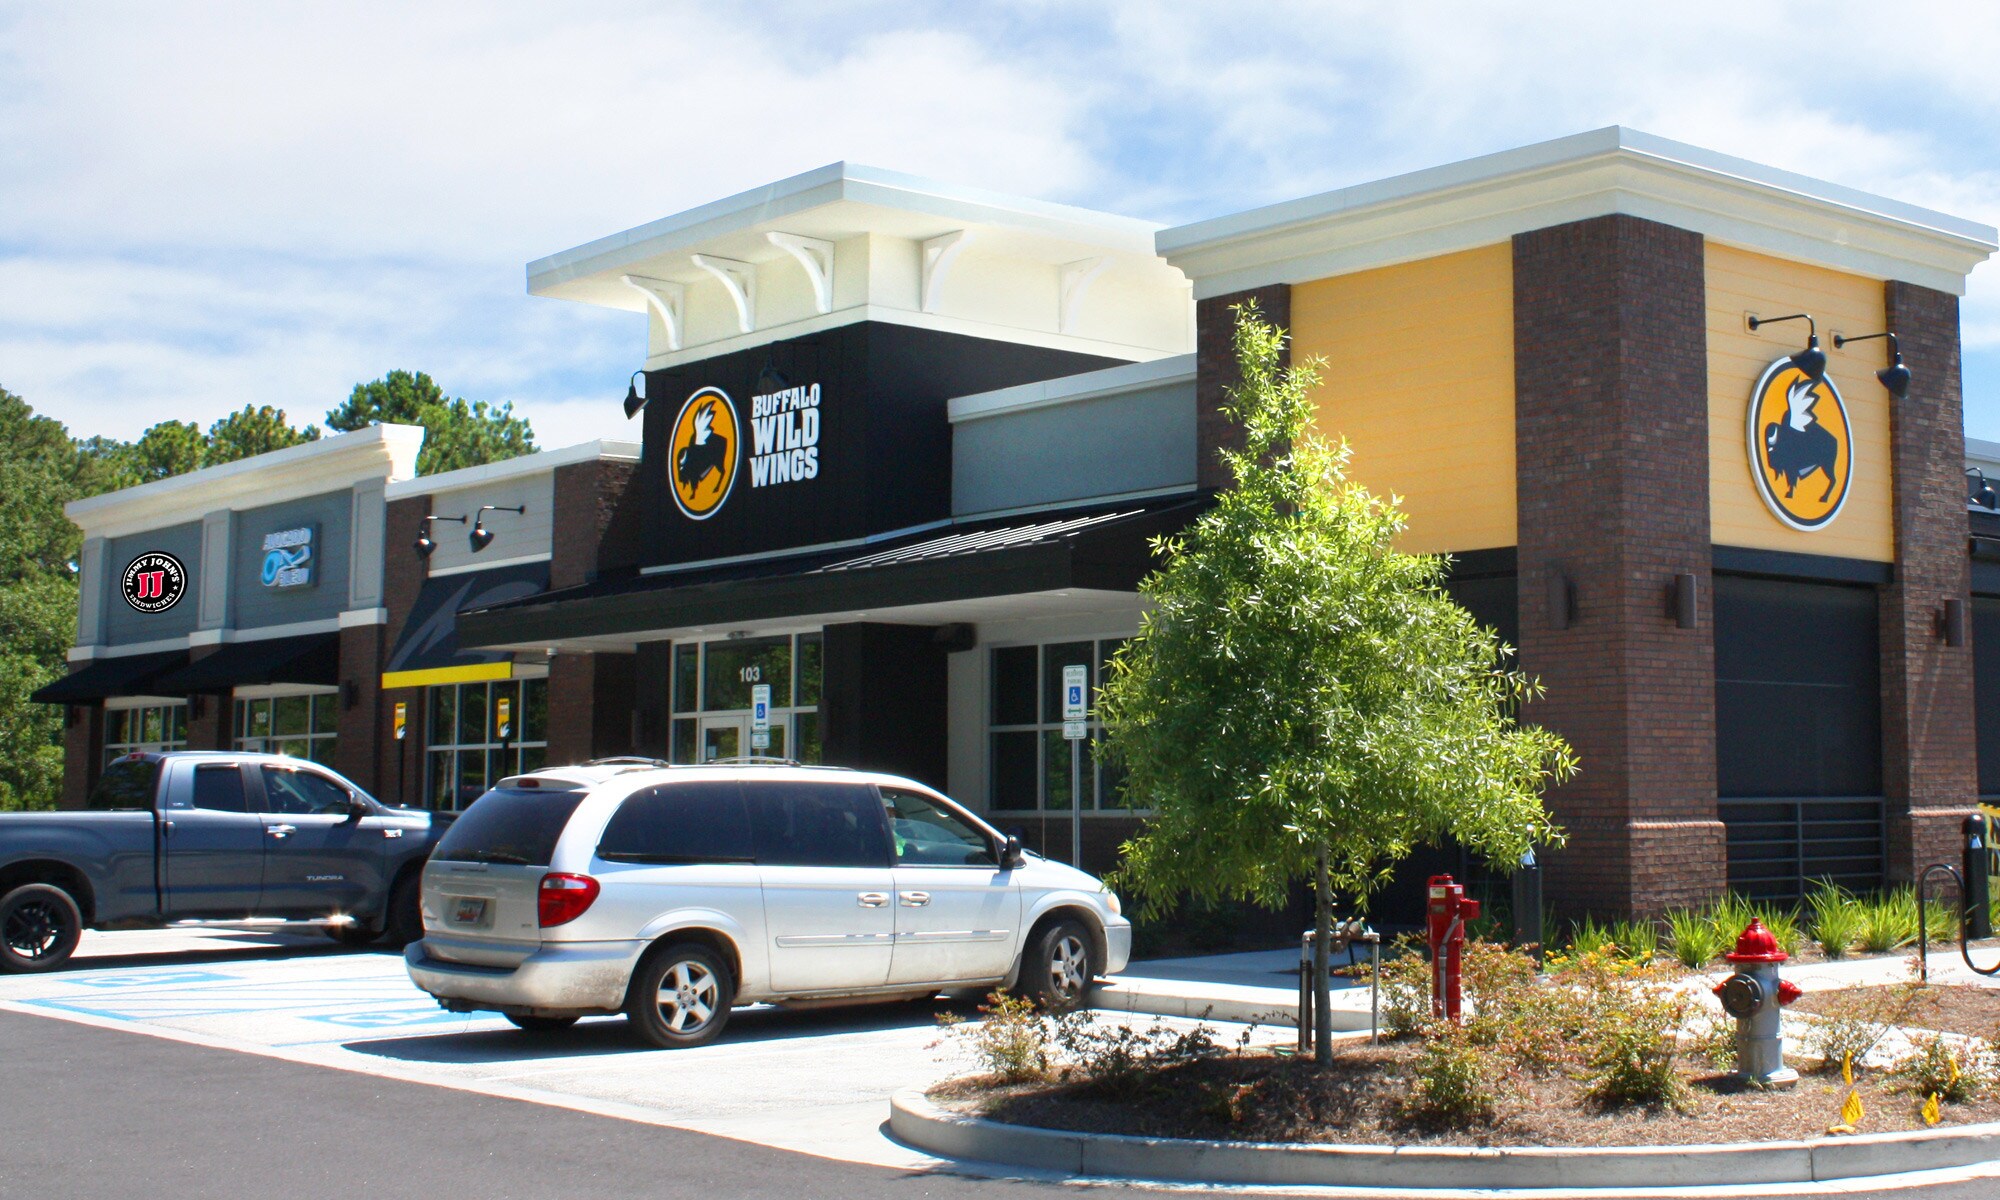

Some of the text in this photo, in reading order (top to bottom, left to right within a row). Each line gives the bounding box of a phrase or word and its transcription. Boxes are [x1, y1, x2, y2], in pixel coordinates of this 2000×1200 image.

[752, 383, 821, 419] BUFFALO
[751, 407, 820, 456] WILD
[749, 446, 819, 488] WINGS
[126, 557, 180, 586] JIMMY JOHN'S
[137, 570, 165, 598] JJ
[129, 592, 176, 609] SANDWICHES
[739, 666, 761, 682] 103
